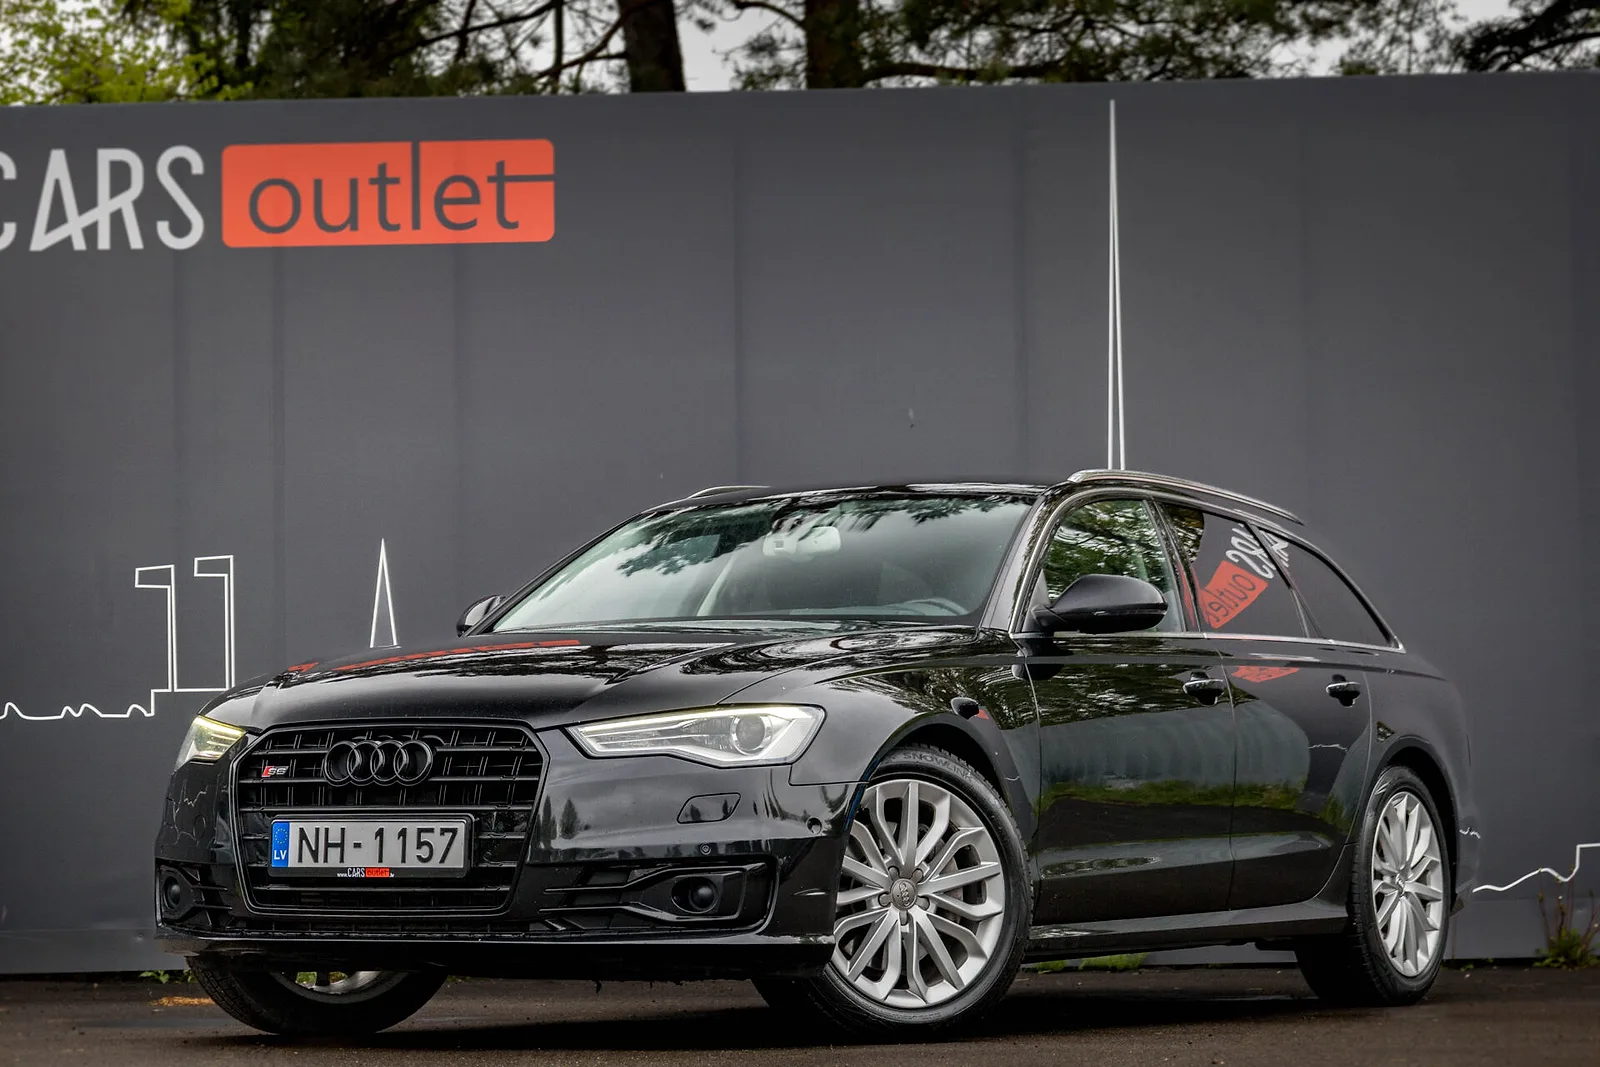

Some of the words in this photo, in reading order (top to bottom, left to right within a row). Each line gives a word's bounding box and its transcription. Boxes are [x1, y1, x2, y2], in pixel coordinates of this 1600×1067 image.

[248, 141, 554, 235] outlet
[273, 849, 287, 860] LV
[298, 827, 458, 864] NH-1157
